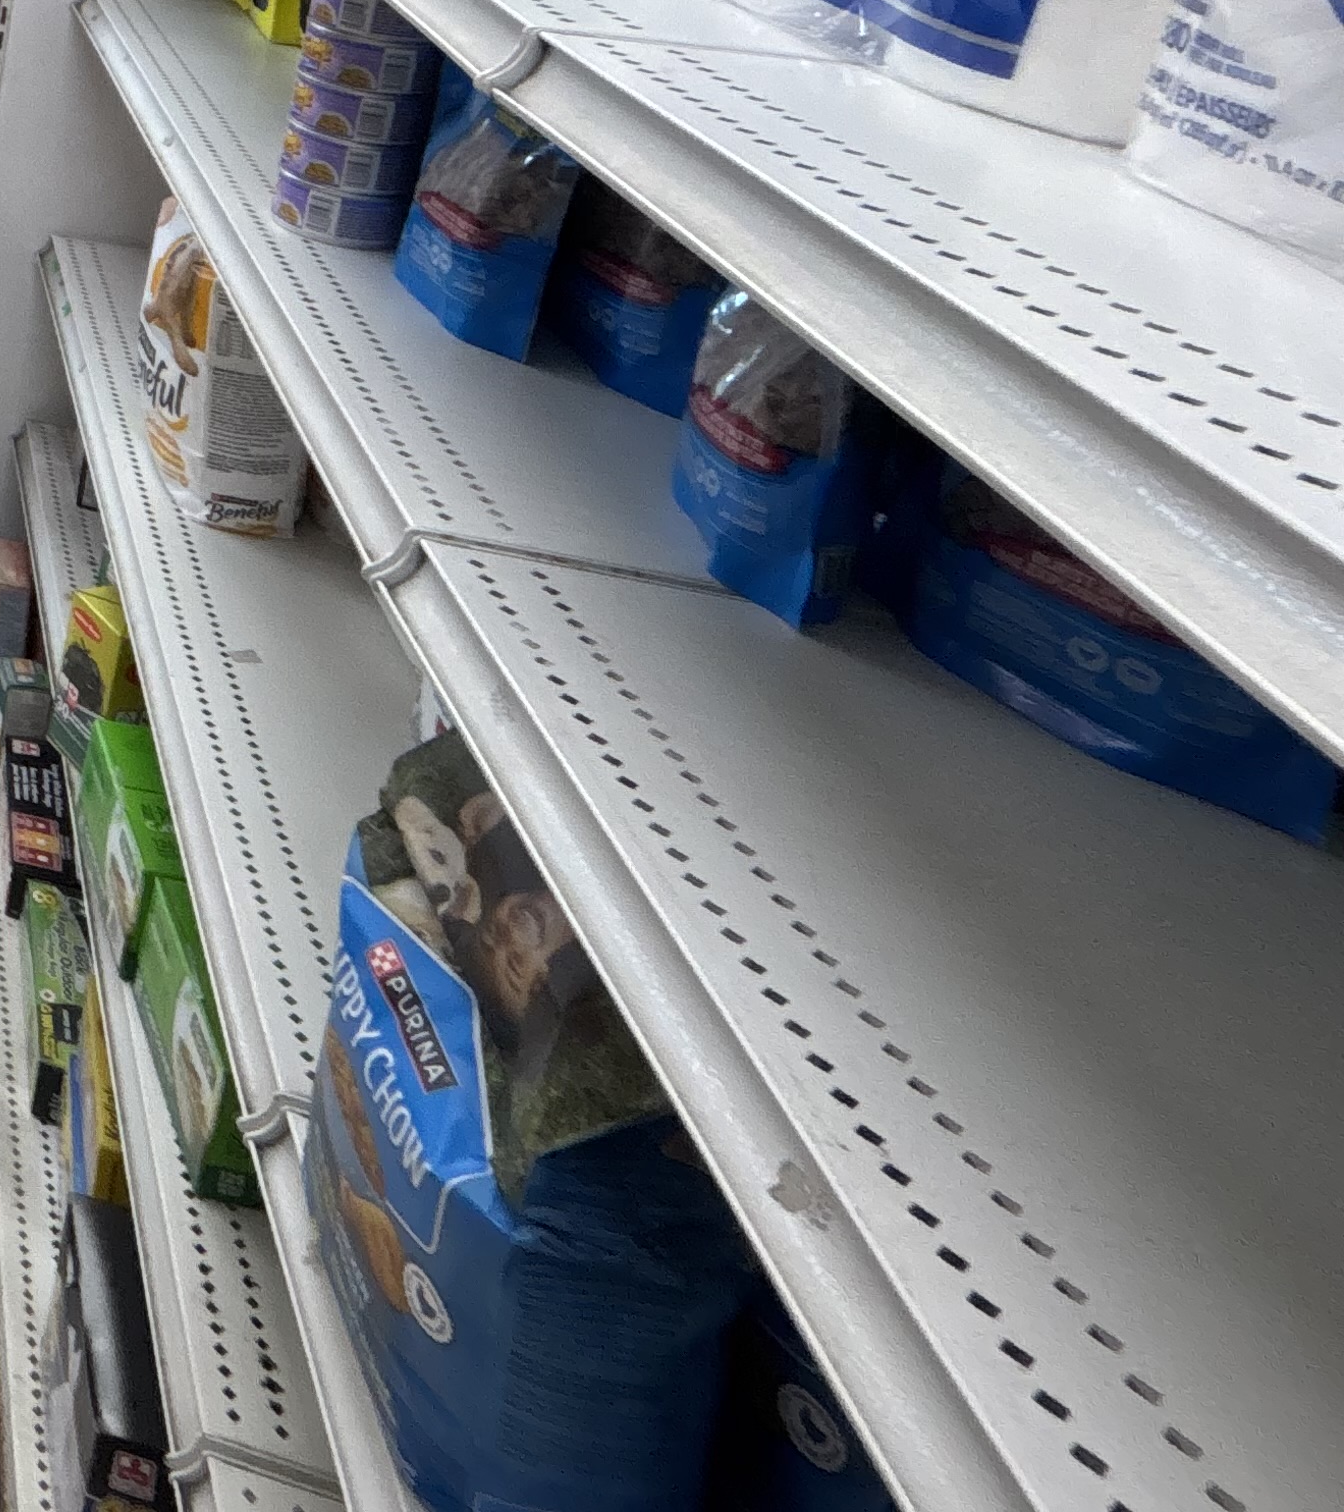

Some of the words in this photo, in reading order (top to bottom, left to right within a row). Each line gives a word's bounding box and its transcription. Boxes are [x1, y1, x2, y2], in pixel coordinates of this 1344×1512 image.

[334, 950, 382, 1048] UPPY
[363, 1046, 433, 1190] CHOW
[385, 974, 448, 1086] PURINA
